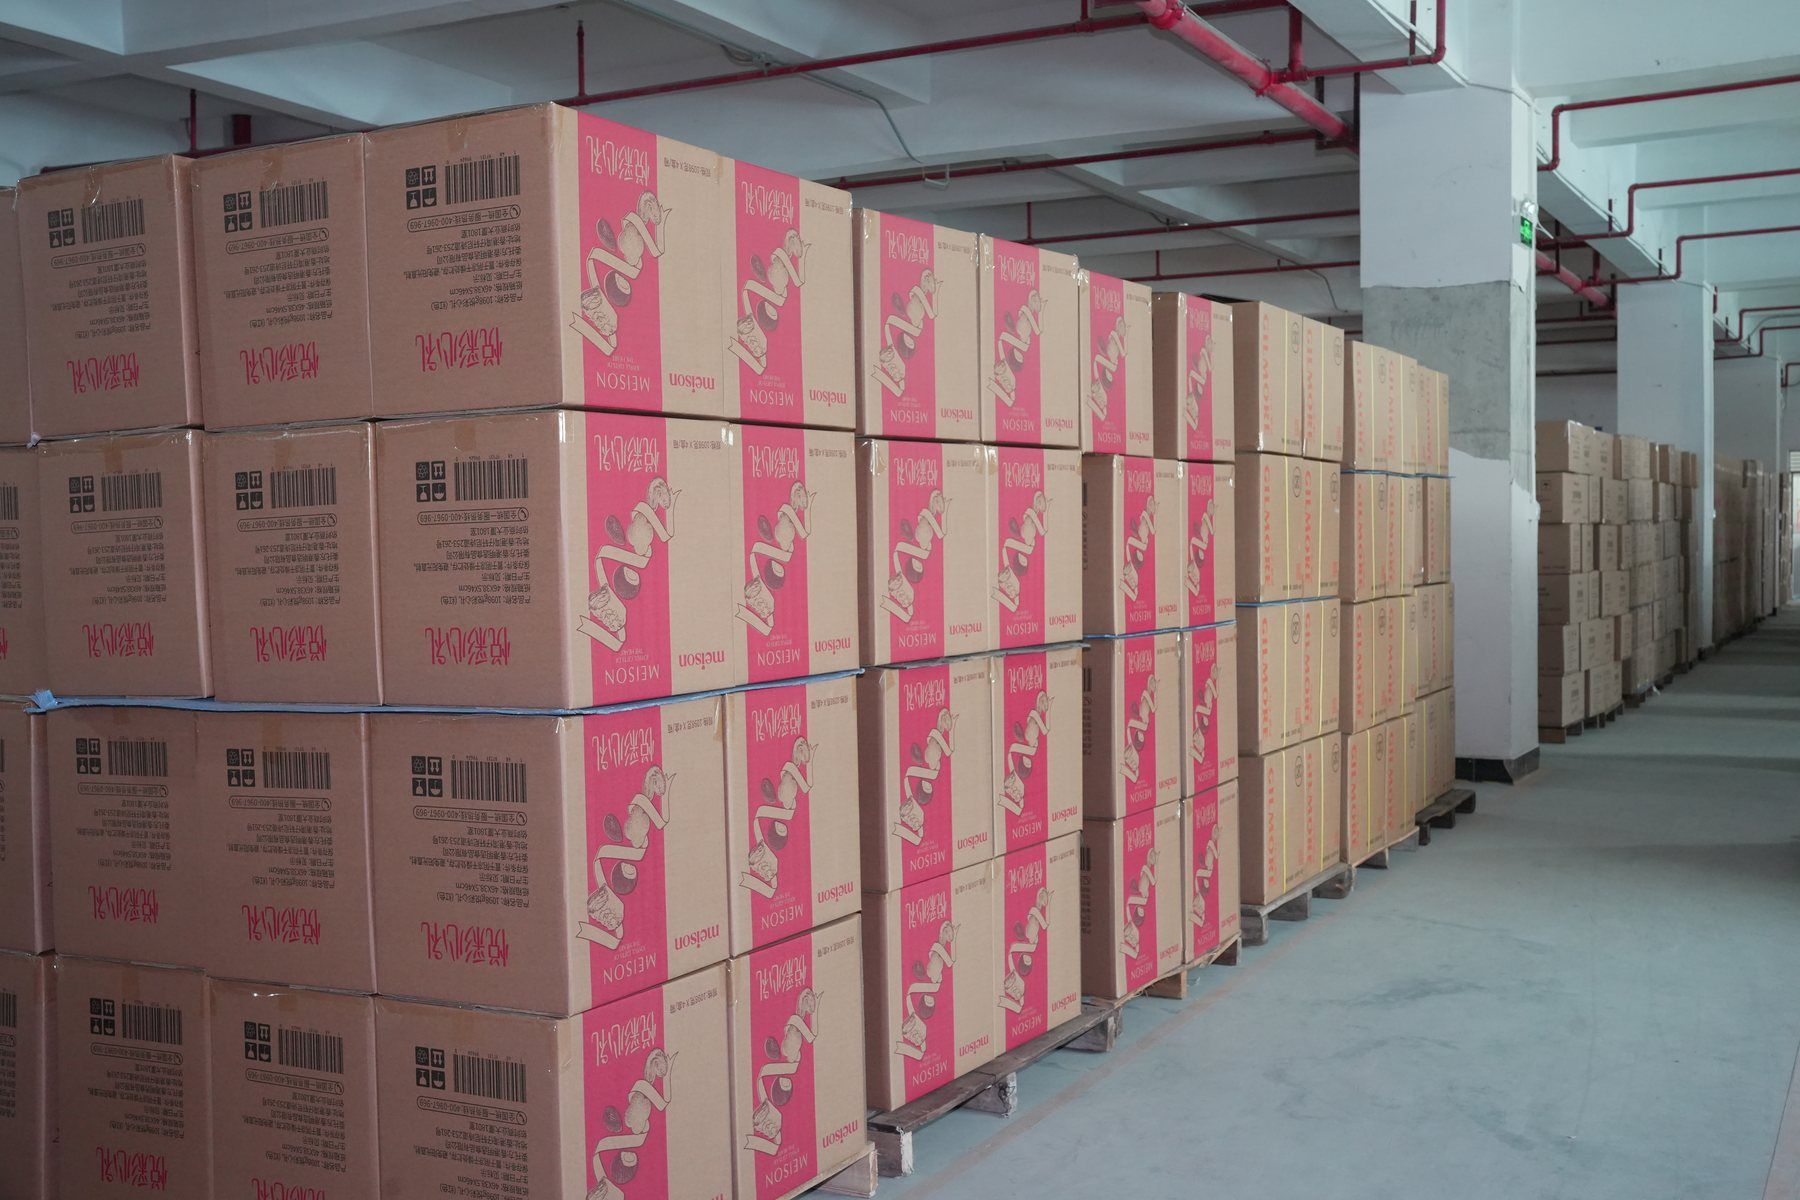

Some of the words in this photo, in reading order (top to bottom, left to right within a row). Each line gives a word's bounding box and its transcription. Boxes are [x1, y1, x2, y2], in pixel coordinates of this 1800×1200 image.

[597, 371, 650, 392] MEISON
[669, 372, 715, 393] meison
[750, 389, 794, 406] MEISON
[809, 388, 847, 406] meison
[891, 410, 927, 423] MEISON
[940, 409, 971, 423] meison
[899, 633, 936, 648] MEISON
[950, 624, 981, 639] meison
[758, 648, 799, 666] MEISON
[815, 638, 850, 655] meison
[678, 652, 724, 671] meison
[605, 664, 659, 685] MEISON
[957, 831, 988, 850] meison
[911, 850, 945, 872] MEISON
[818, 880, 853, 904] meison
[761, 903, 803, 930] MEISON
[675, 925, 719, 952] meison
[604, 953, 656, 986] MEISON
[959, 1035, 989, 1059] meison
[913, 1059, 947, 1086] MEISON
[822, 1119, 857, 1150] meison
[765, 1151, 807, 1187] MEISON
